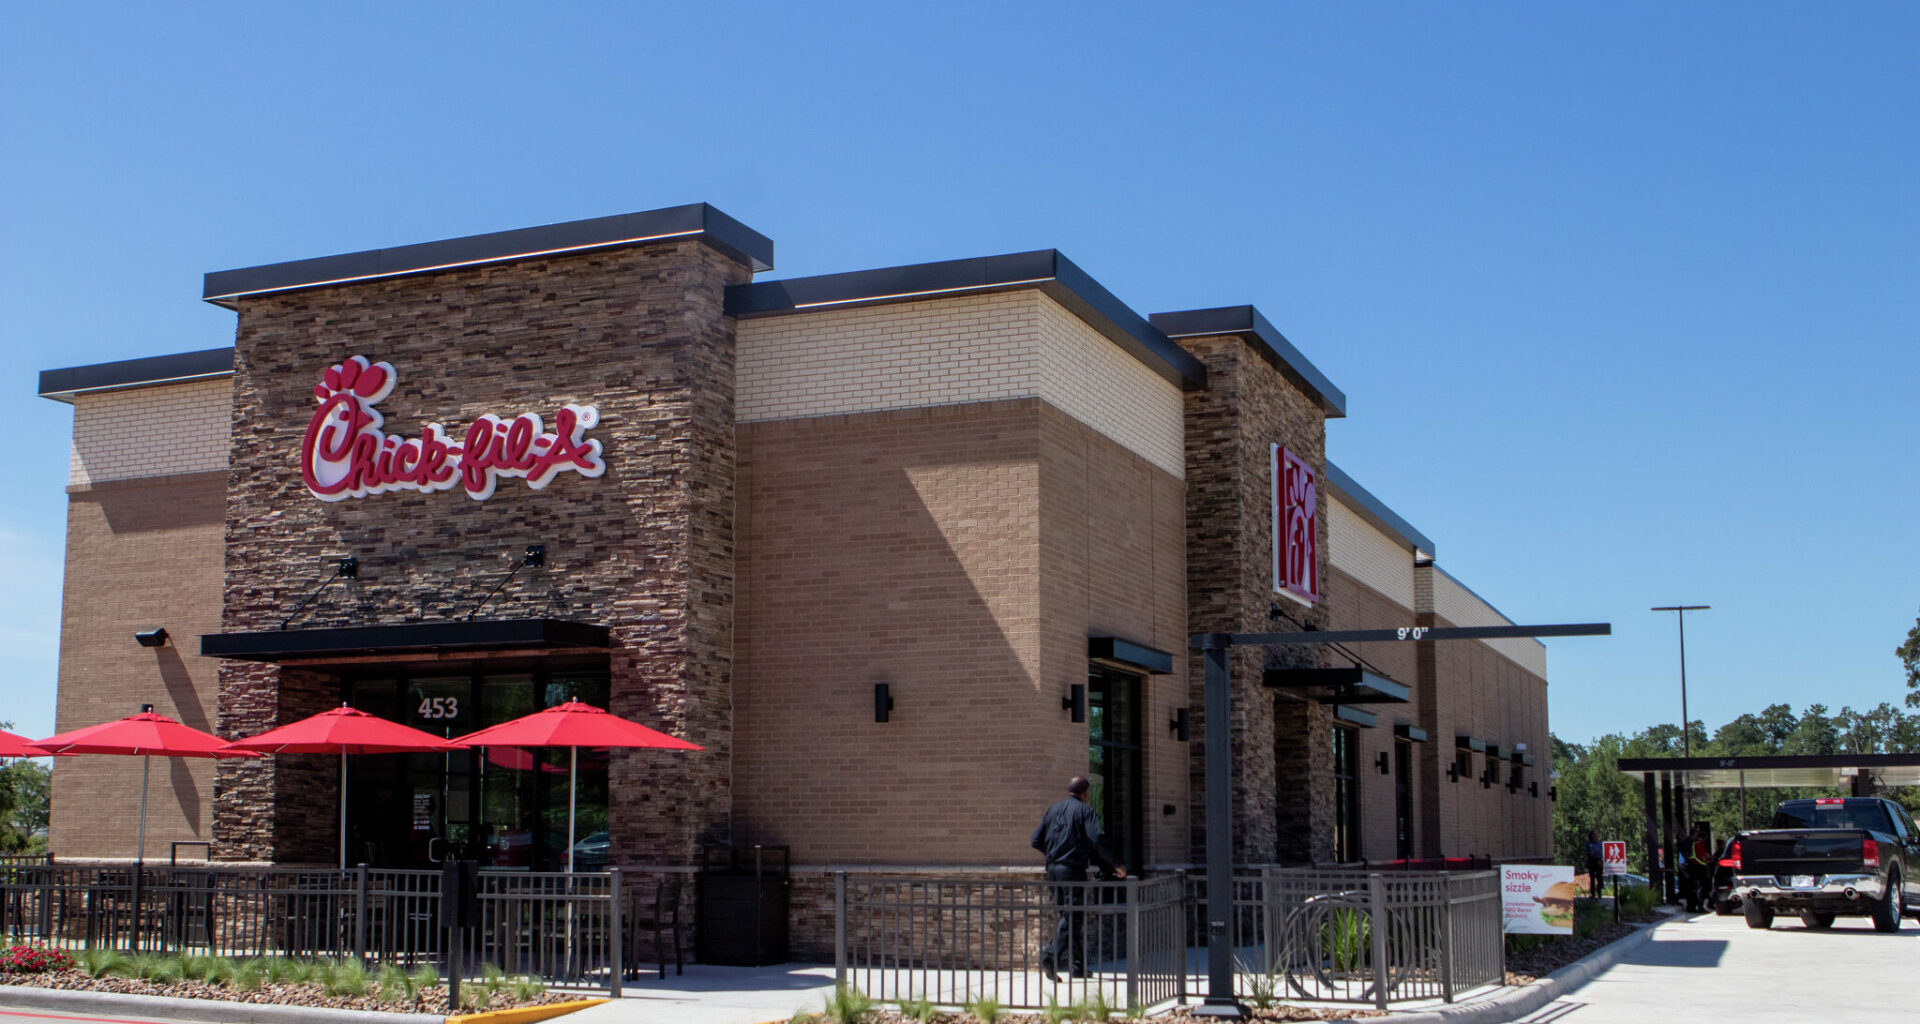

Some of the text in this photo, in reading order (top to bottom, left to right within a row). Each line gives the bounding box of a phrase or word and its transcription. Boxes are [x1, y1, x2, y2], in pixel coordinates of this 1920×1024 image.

[302, 357, 601, 497] Chick-fil-A
[418, 697, 458, 719] 453
[1505, 870, 1539, 882] Smoky
[1505, 883, 1531, 892] sizzle
